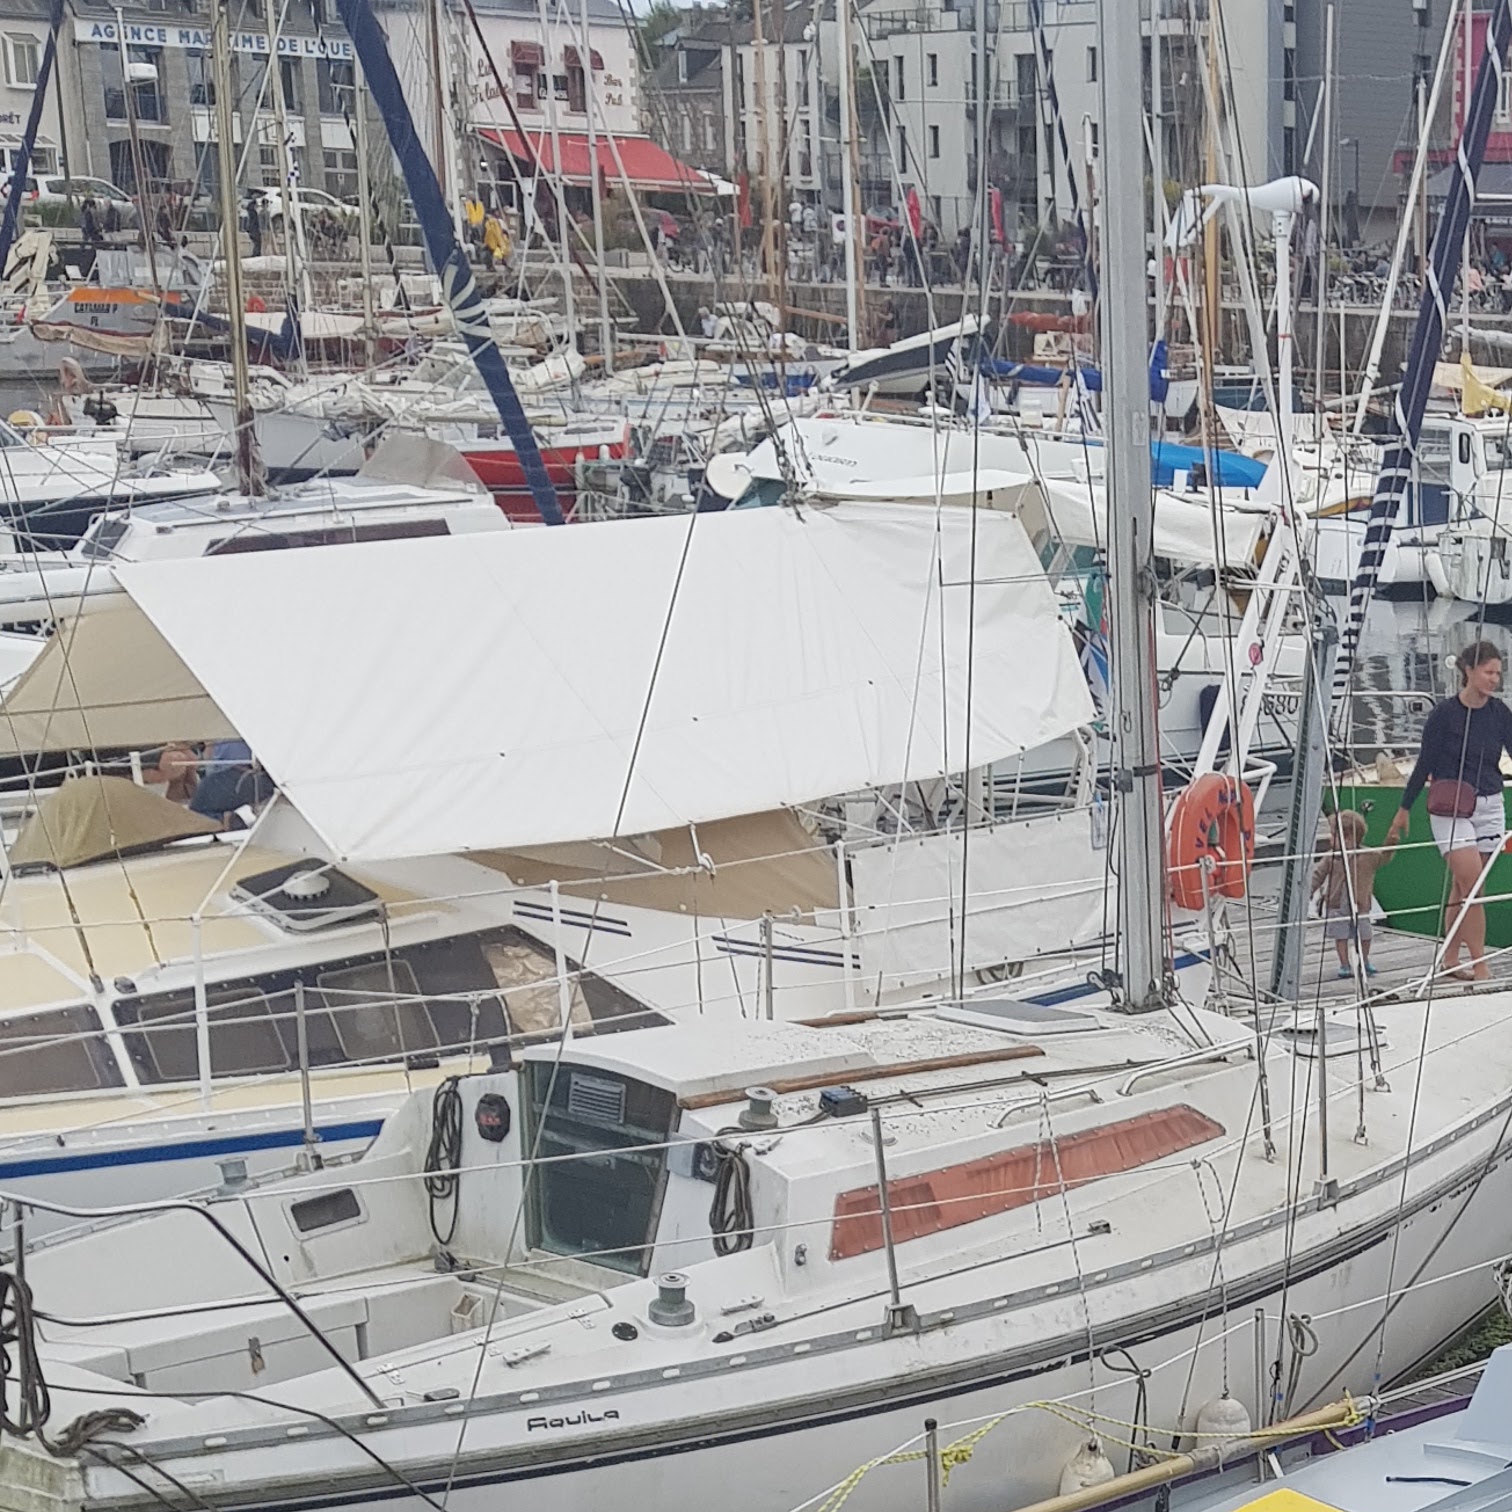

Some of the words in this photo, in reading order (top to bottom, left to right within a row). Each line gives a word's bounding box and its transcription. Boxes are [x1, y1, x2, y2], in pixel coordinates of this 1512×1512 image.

[178, 29, 267, 50] MARTIME
[277, 38, 299, 52] DE
[305, 41, 352, 57] L'OUE
